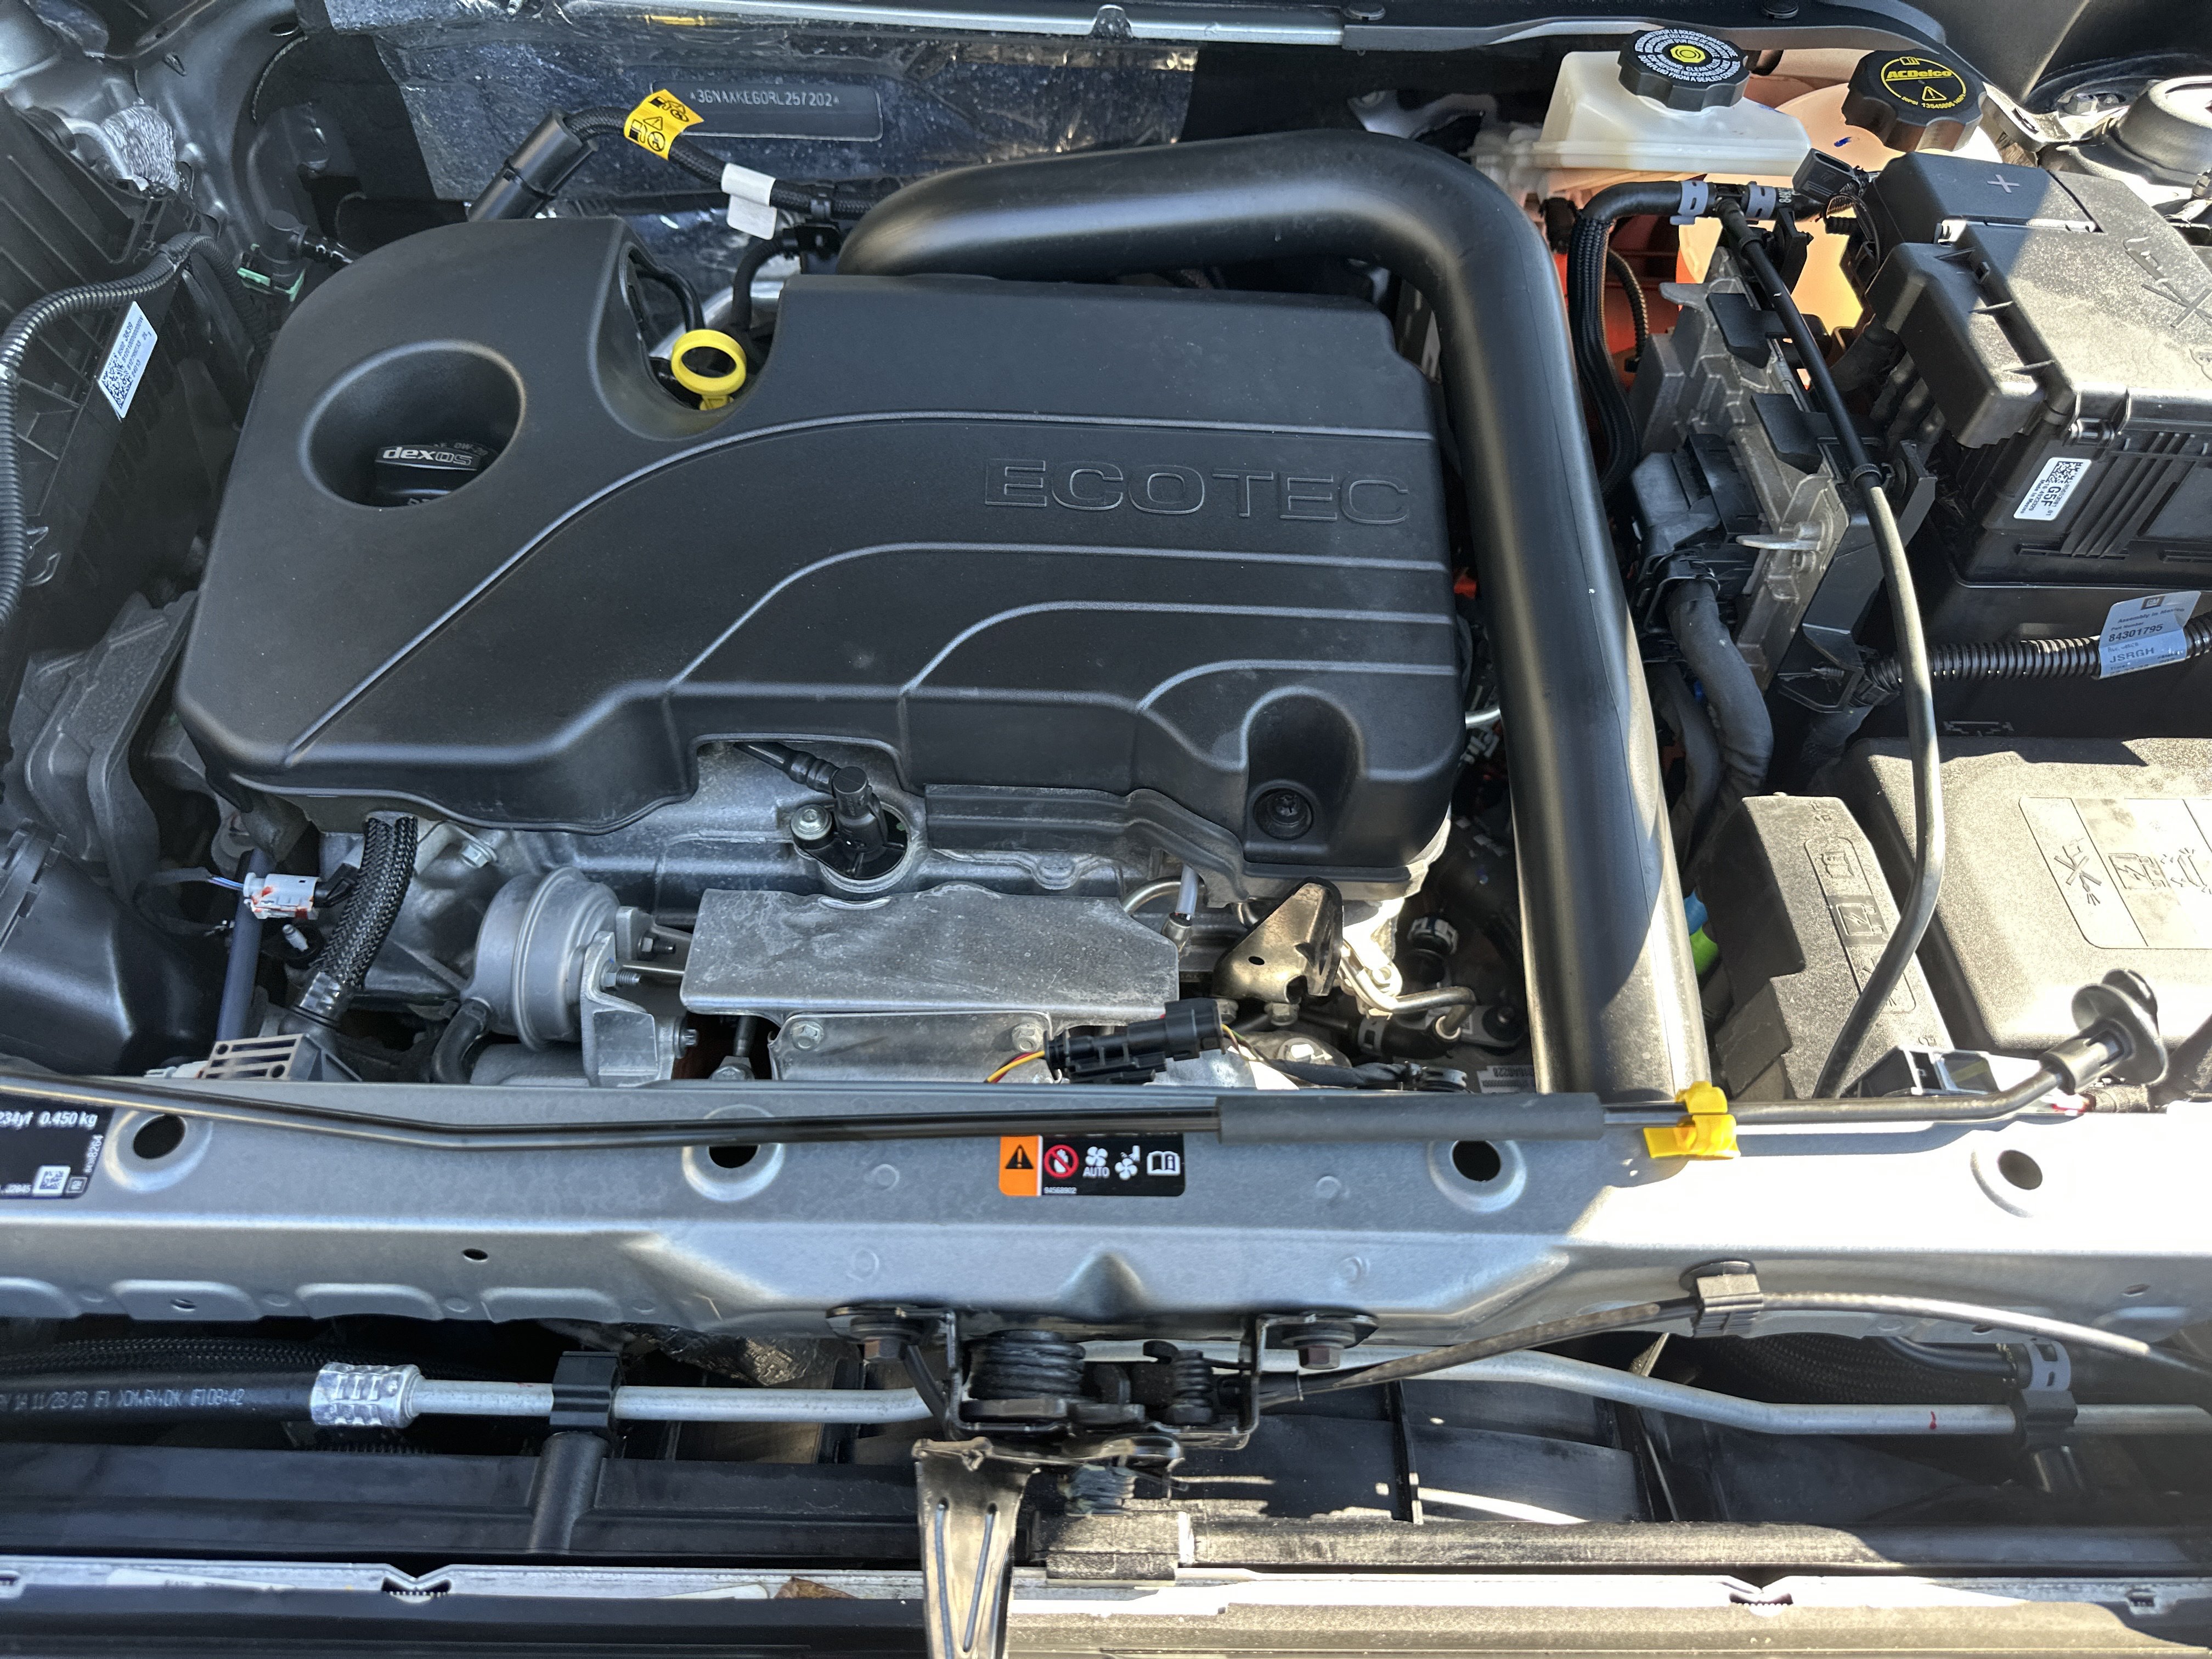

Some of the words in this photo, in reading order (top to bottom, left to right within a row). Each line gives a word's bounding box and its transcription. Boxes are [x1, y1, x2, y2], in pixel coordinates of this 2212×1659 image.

[1886, 69, 1953, 78] ACDelco
[382, 446, 473, 466] dexos
[985, 458, 1409, 525] ECOTEC
[2041, 486, 2062, 506] G5F
[2117, 613, 2150, 624] Assembly
[2108, 623, 2164, 642] 84301795
[38, 1111, 78, 1125] 0.450
[79, 1111, 98, 1130] kg
[1082, 1166, 1110, 1178] AUTO
